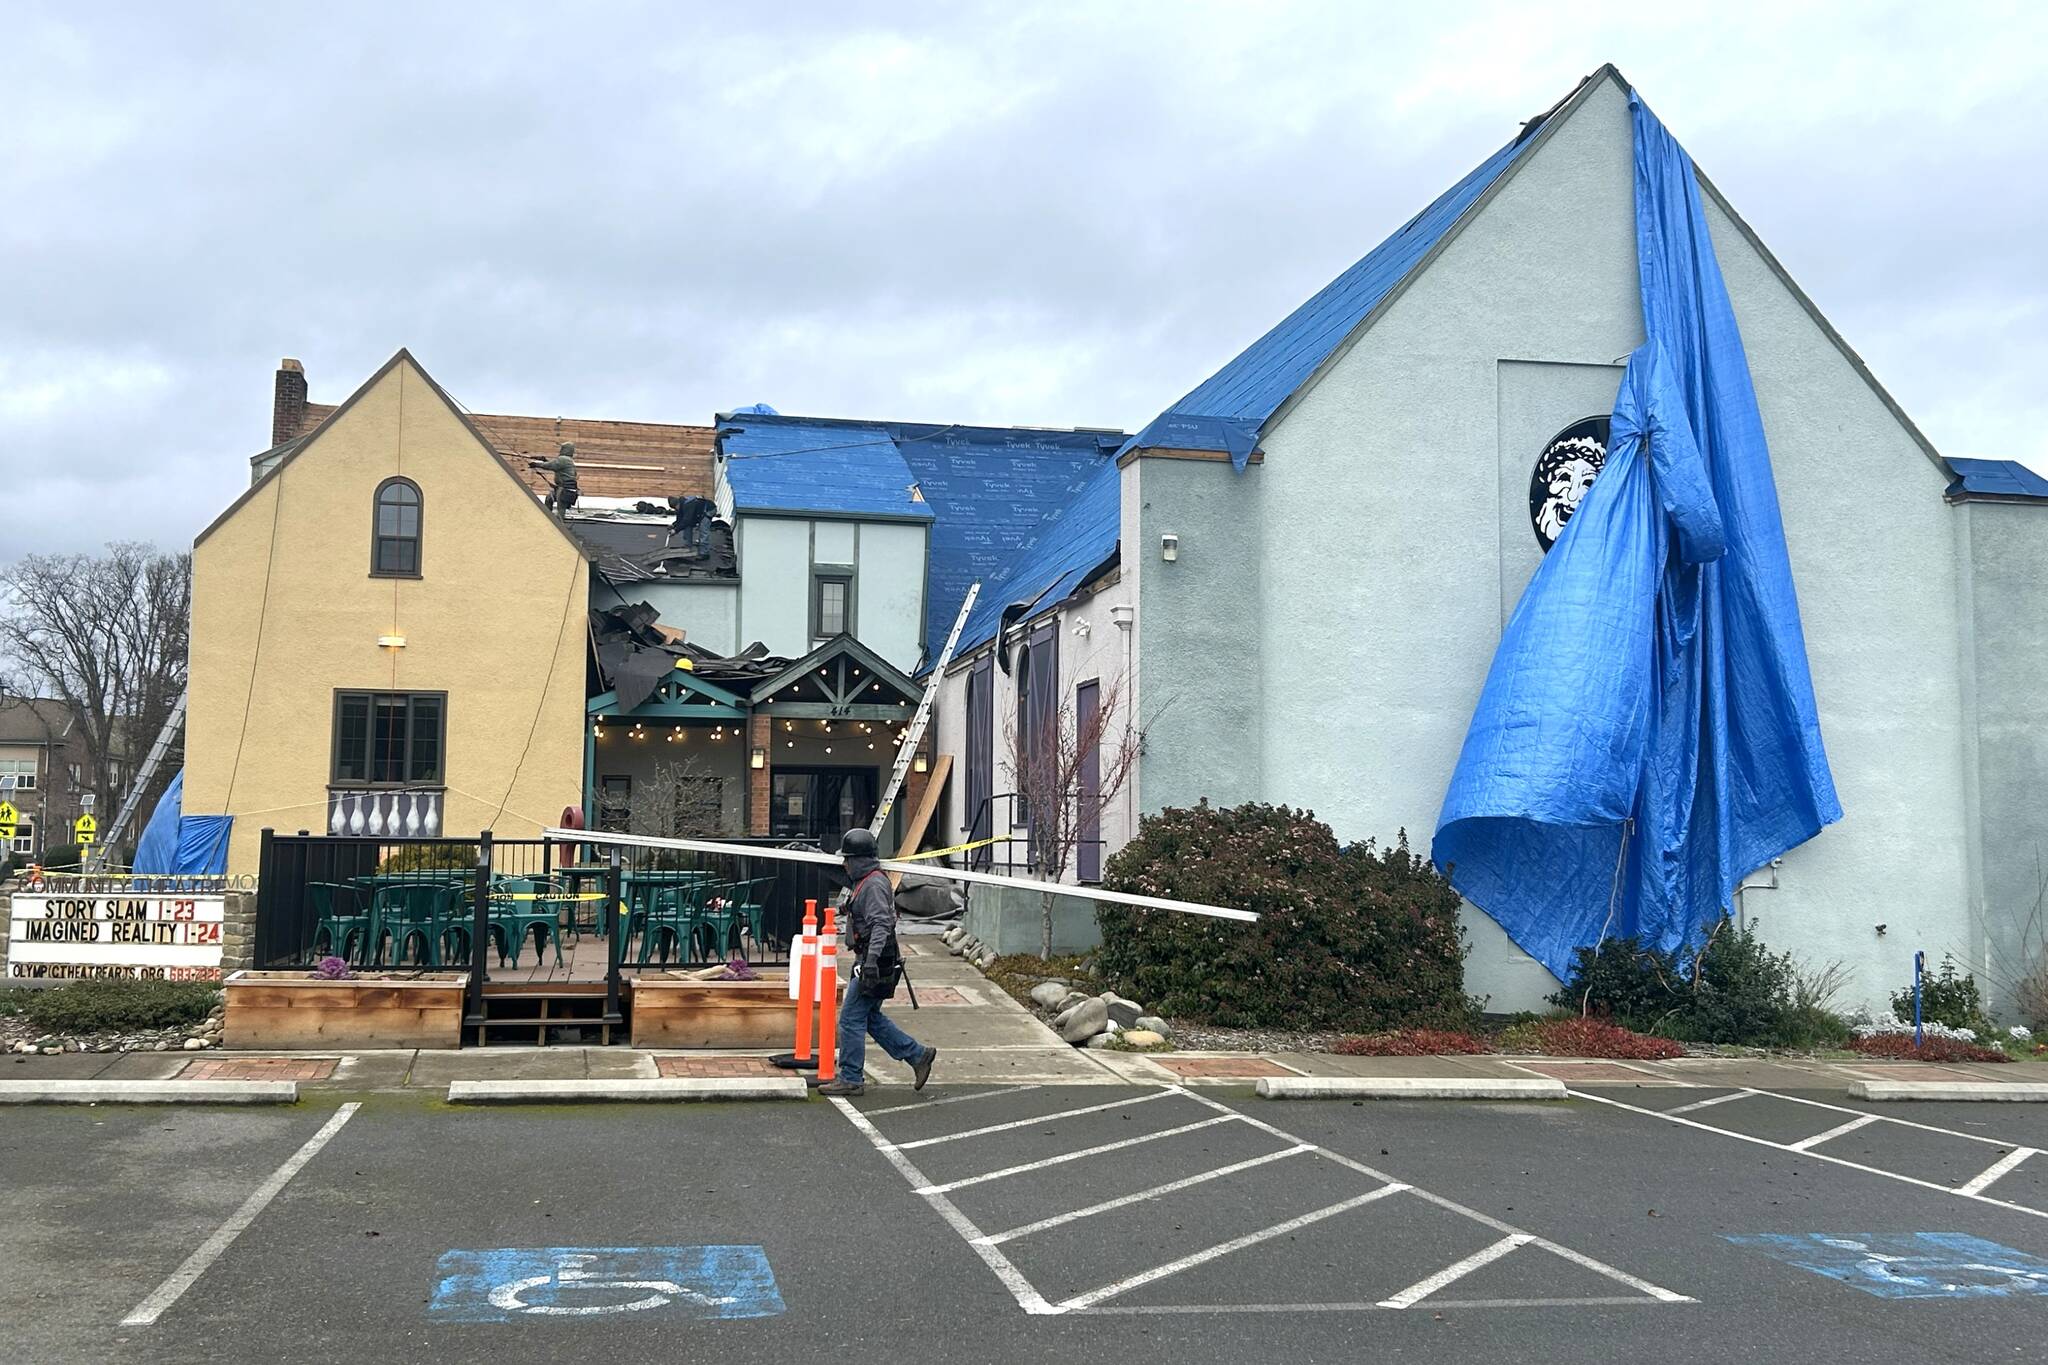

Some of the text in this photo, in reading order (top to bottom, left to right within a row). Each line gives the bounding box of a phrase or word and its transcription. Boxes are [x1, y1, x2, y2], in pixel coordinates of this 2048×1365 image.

[1005, 441, 1031, 450] Tyvek
[1035, 442, 1061, 451] Tyvek
[831, 705, 851, 717] 414
[535, 892, 580, 900] CAUTION
[45, 900, 195, 921] STORY SLAM 1-23
[26, 920, 220, 943] IMAGINED REALITY 1-24
[13, 964, 164, 980] OLYMPICTHEATREARTS.ORG
